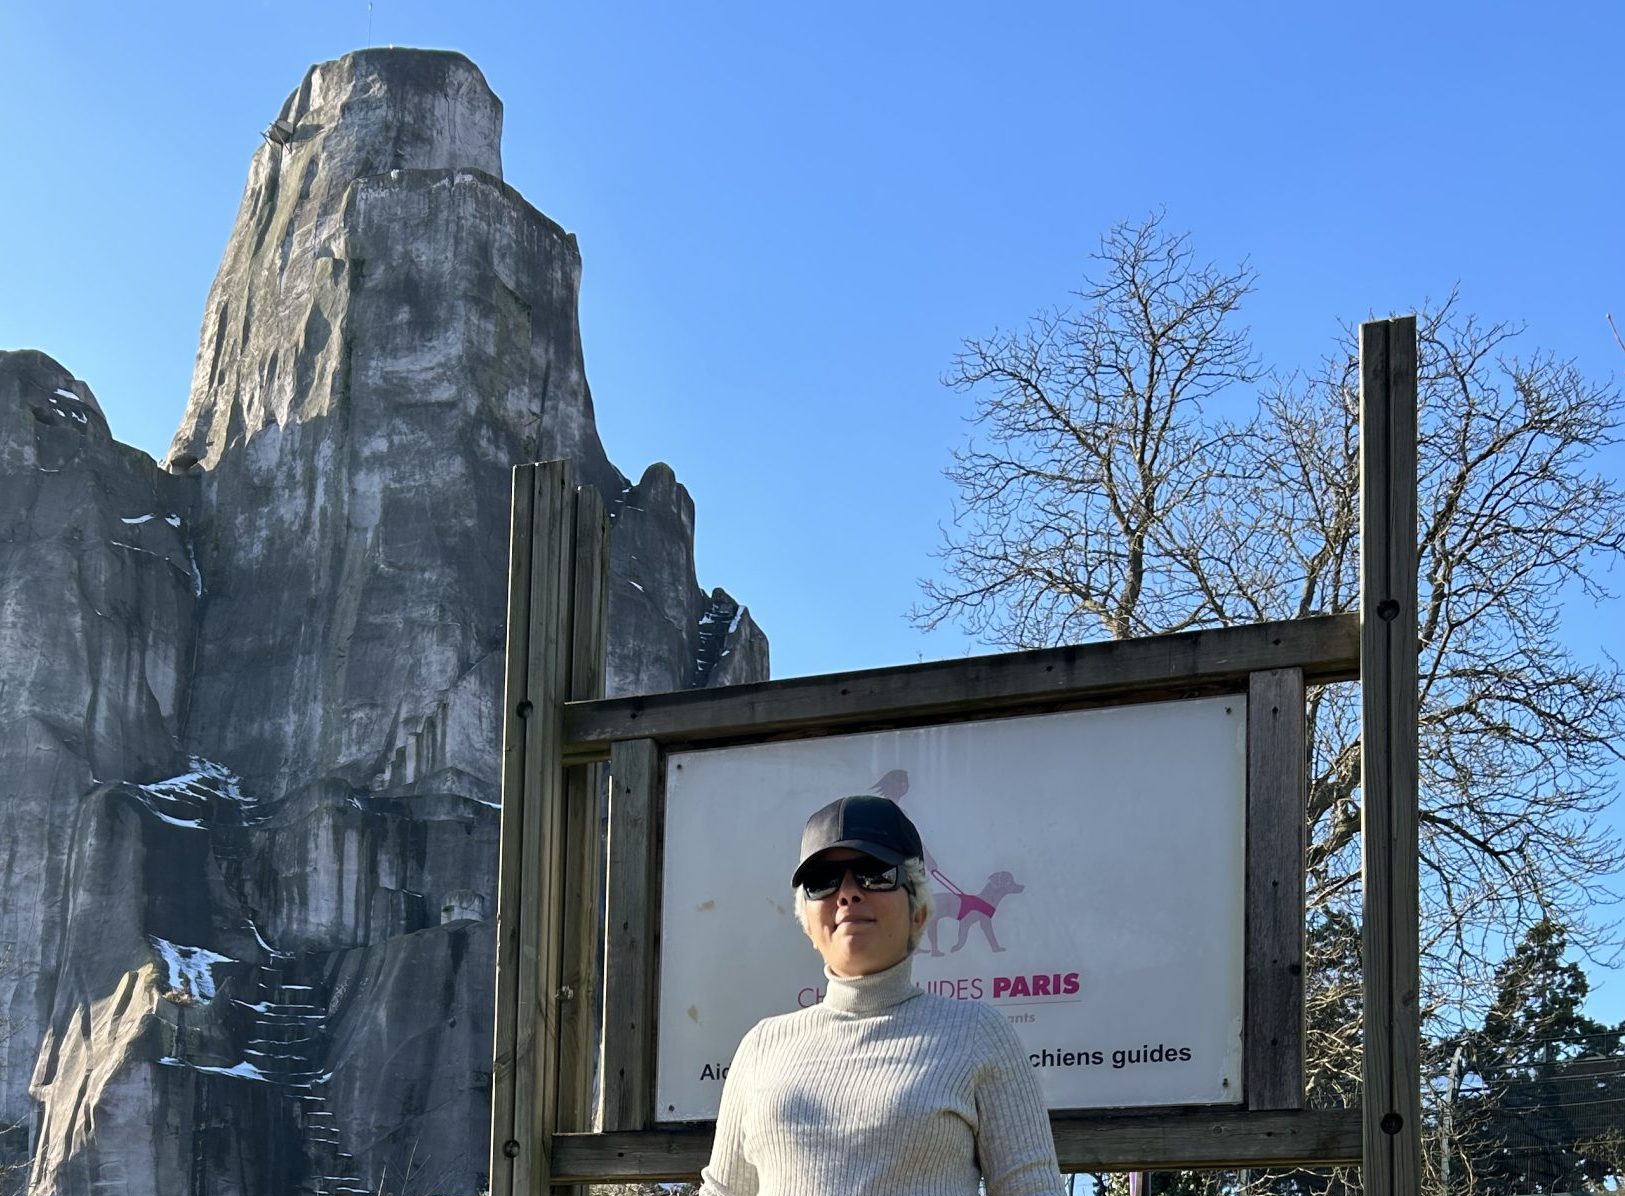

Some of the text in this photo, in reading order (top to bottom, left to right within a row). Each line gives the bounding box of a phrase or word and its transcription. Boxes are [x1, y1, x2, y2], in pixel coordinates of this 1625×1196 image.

[916, 973, 1080, 1000] IDES PARIS
[1029, 1044, 1192, 1068] chiens guides
